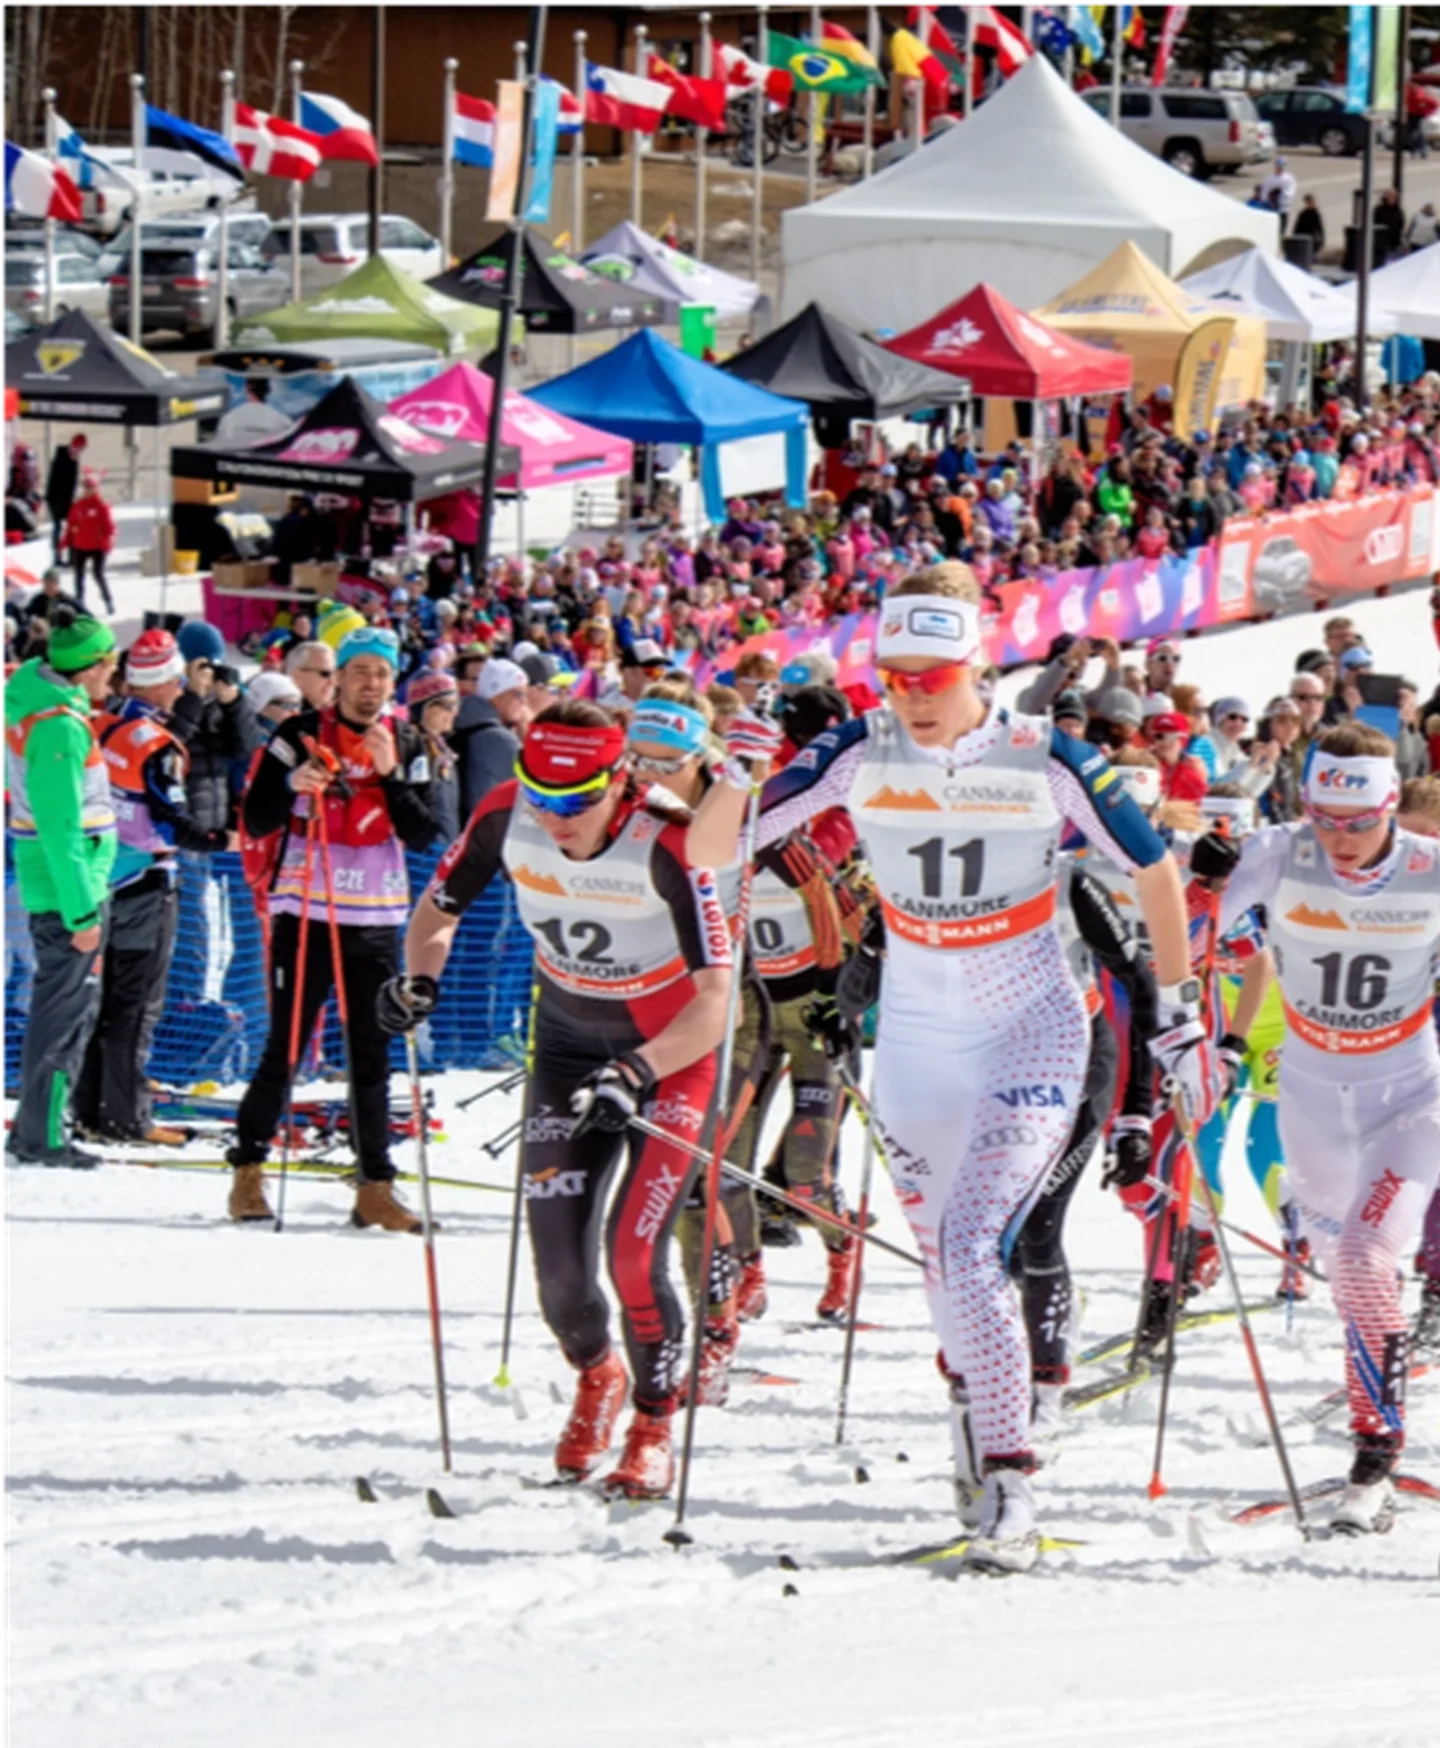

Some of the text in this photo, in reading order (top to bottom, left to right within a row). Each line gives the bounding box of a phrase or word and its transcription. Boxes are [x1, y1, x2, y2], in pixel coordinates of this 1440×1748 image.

[334, 868, 366, 890] CZE
[906, 836, 985, 899] 11
[891, 892, 1011, 920] CANMORE
[532, 917, 615, 965] 12
[894, 916, 1010, 946] VIESSMANN
[1311, 951, 1393, 1012] 16
[1295, 998, 1406, 1031] CANMORE
[993, 1083, 1067, 1108] VISA
